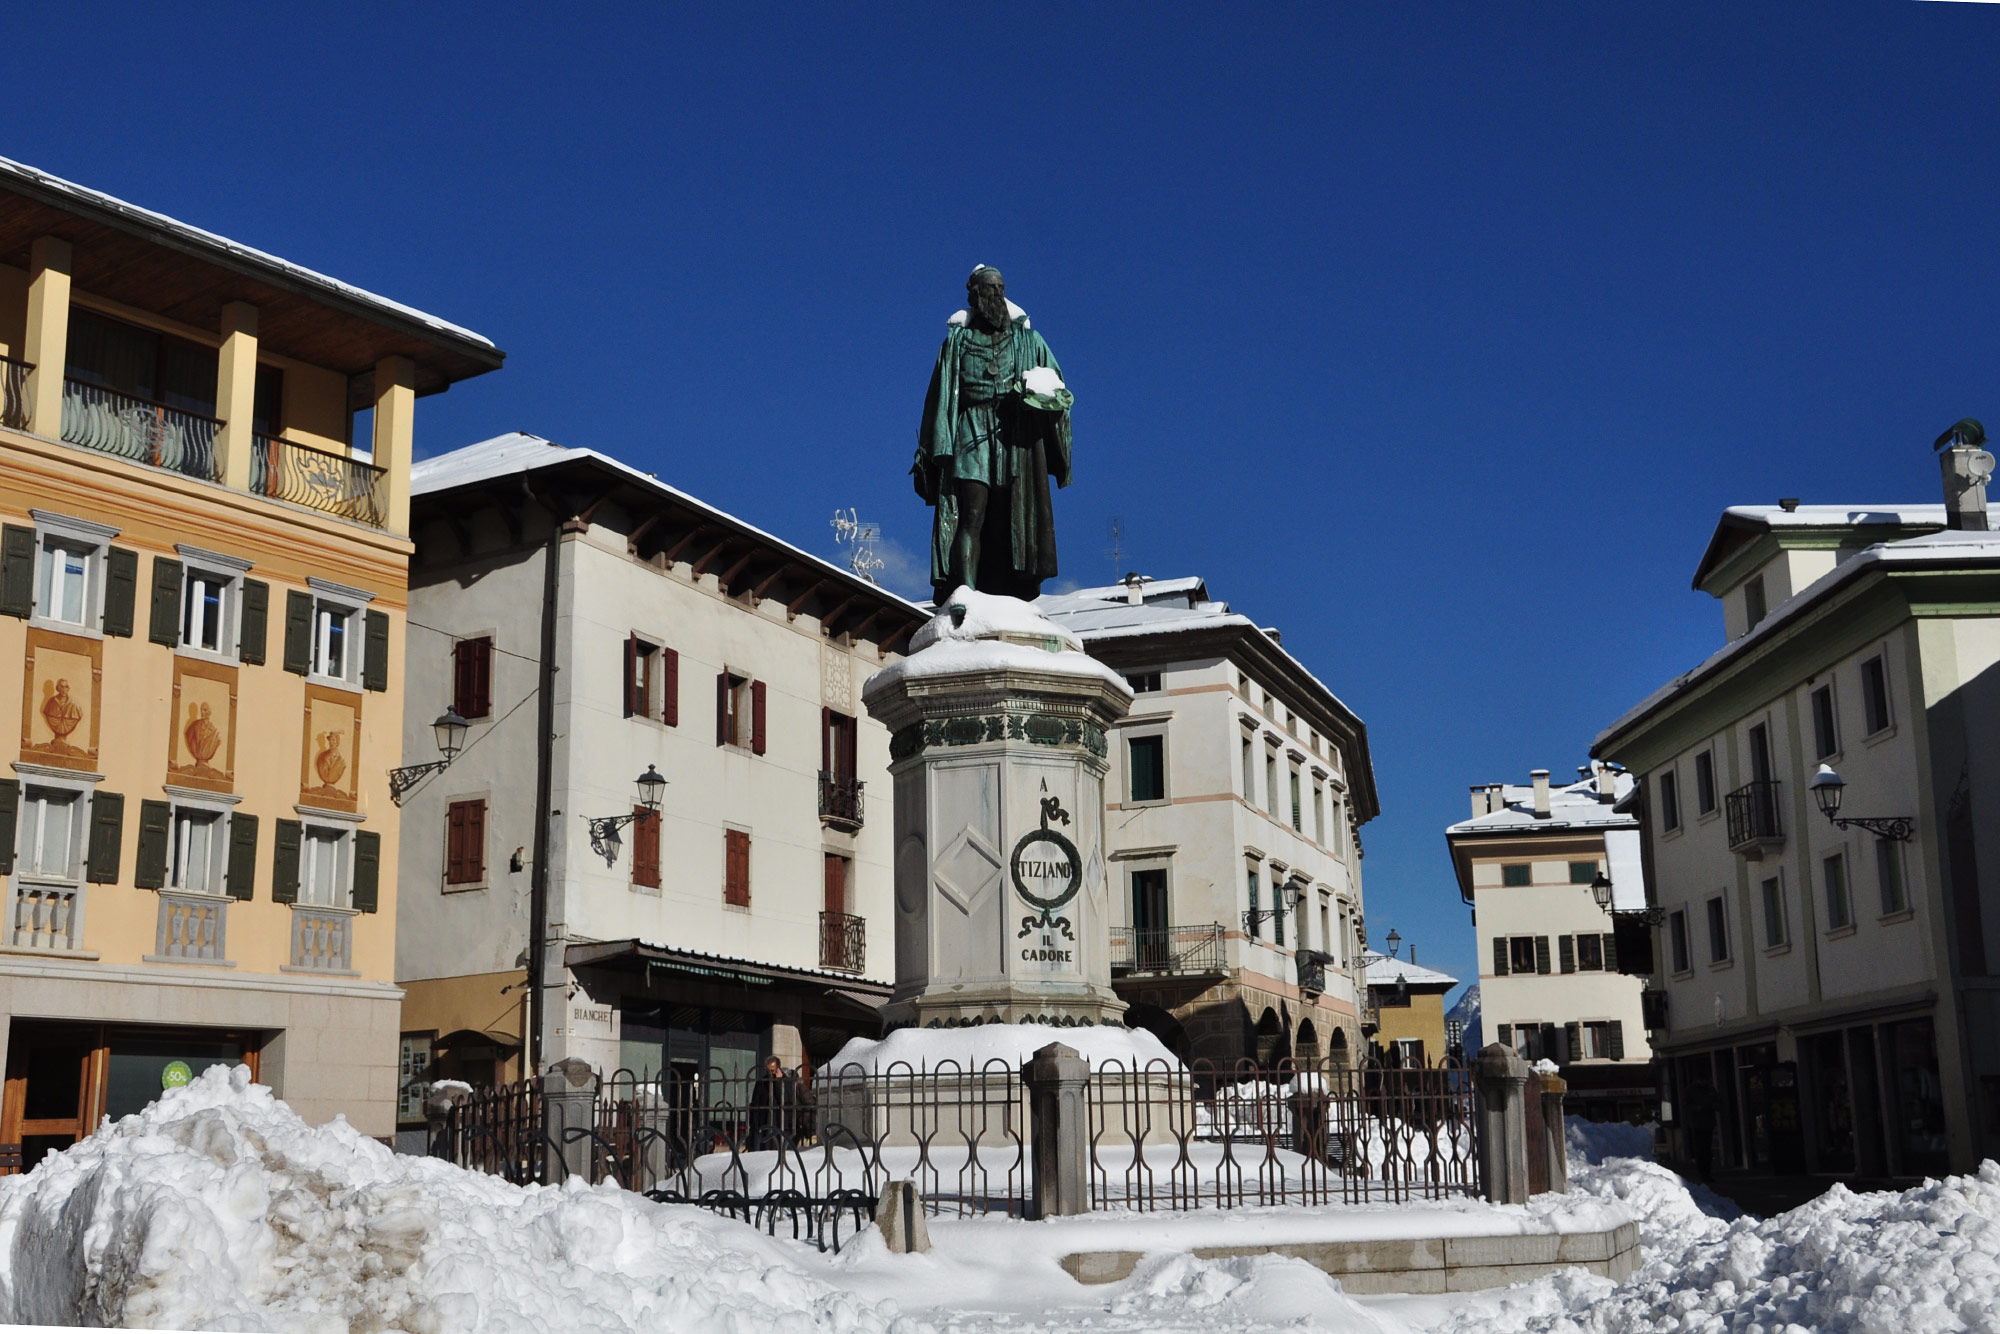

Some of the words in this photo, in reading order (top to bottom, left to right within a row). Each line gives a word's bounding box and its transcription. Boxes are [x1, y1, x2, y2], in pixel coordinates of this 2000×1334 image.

[1039, 776, 1048, 792] A
[1019, 860, 1071, 880] TIZIANO
[1042, 935, 1054, 947] IL
[1021, 949, 1072, 963] CADORE
